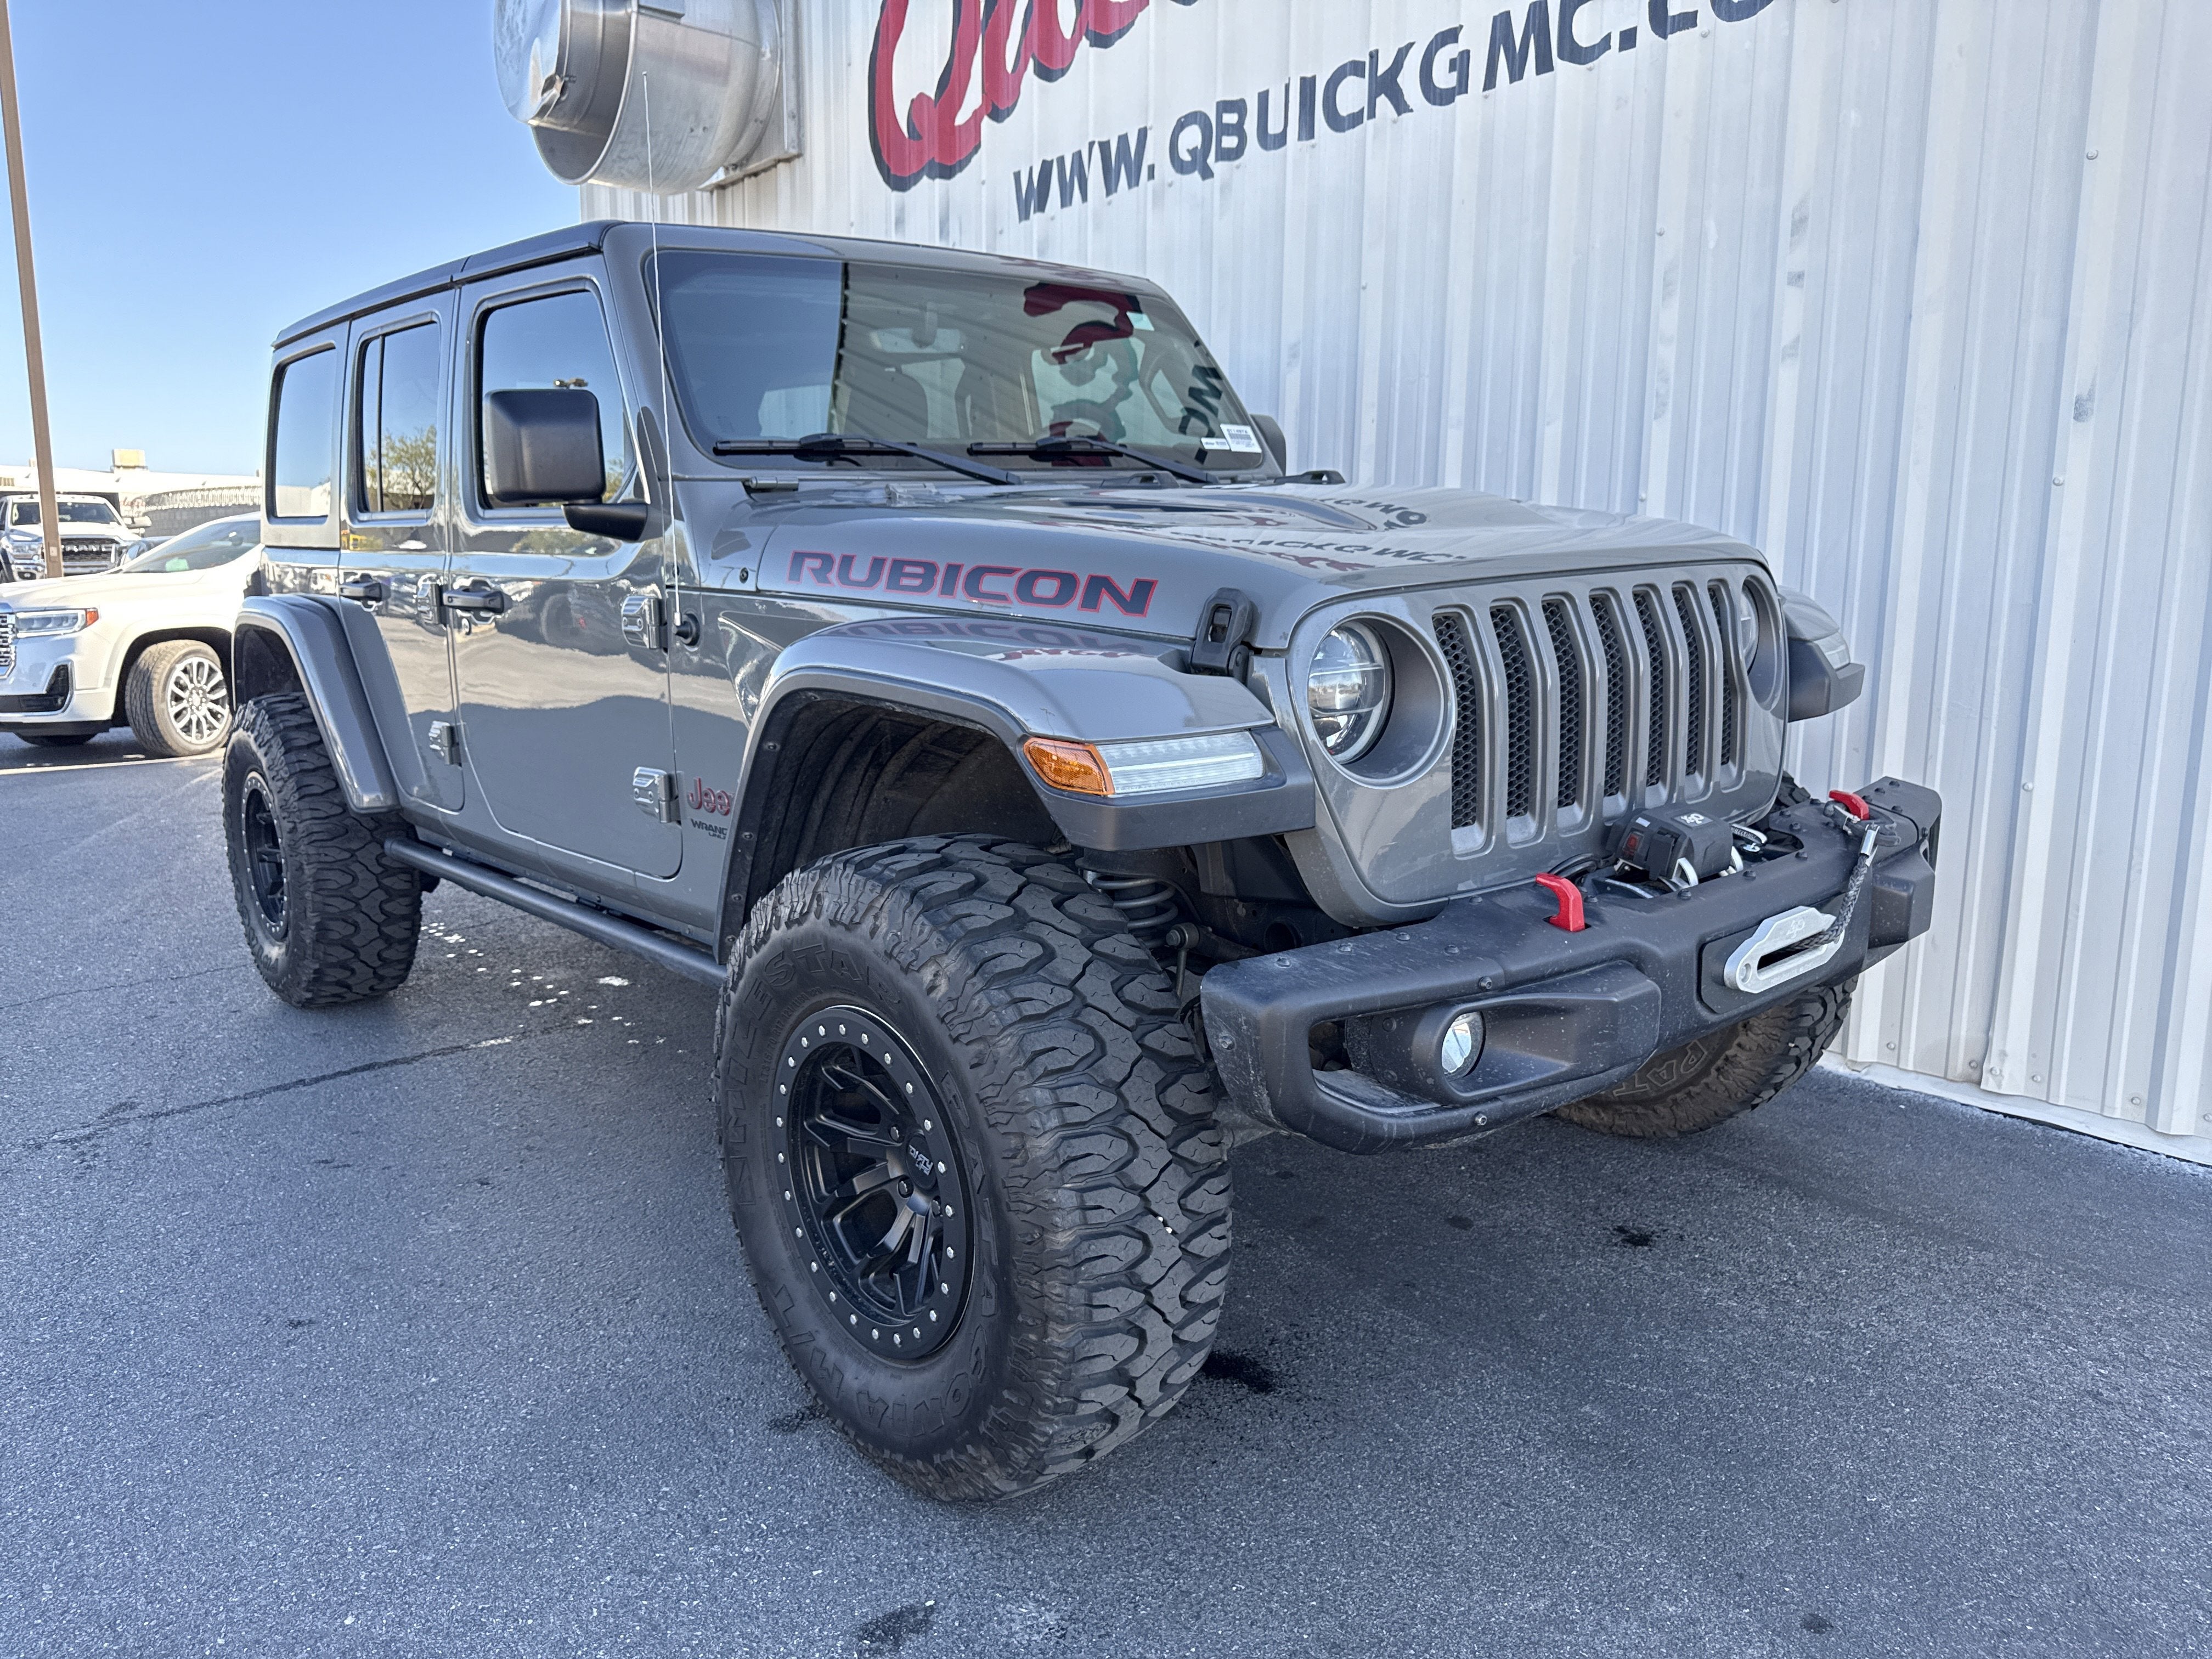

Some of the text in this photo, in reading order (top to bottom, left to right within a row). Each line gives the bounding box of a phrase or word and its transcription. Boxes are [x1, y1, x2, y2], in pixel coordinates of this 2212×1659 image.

[786, 551, 1159, 618] RUBICON
[687, 777, 733, 816] Jee
[691, 818, 728, 836] WRANG
[726, 943, 901, 1143] MILESTAR
